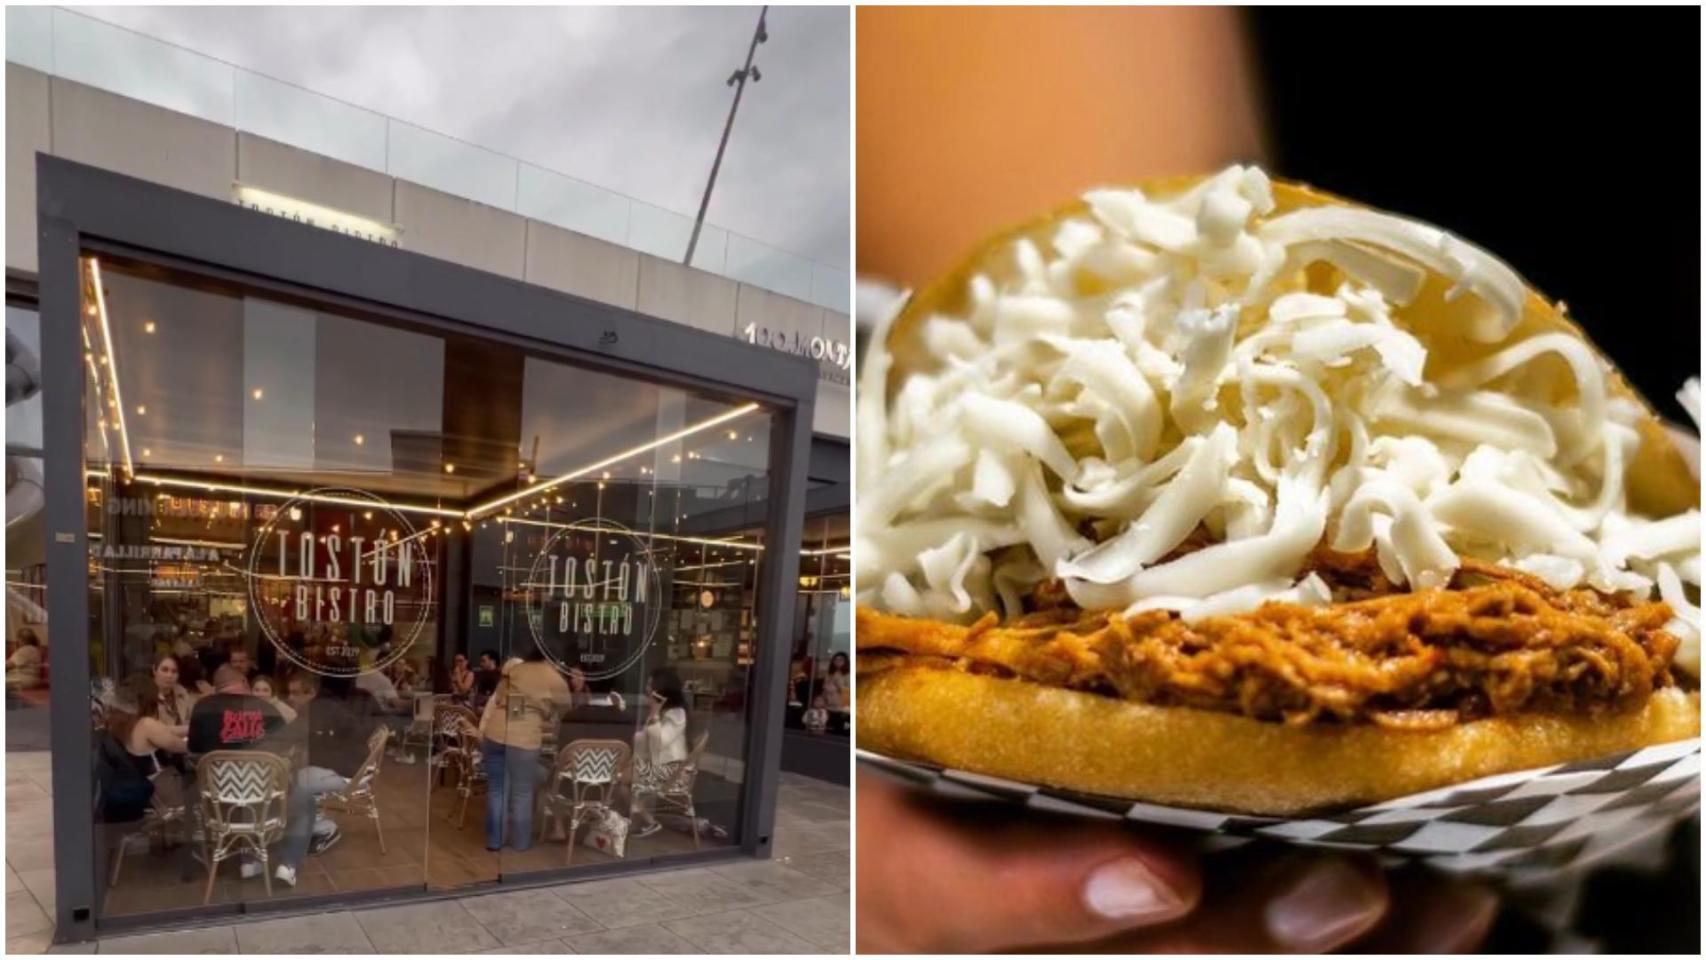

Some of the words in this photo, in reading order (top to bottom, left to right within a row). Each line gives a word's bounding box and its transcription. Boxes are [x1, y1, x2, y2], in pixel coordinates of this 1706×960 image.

[277, 528, 413, 587] TOSTÓN
[548, 553, 647, 603] TOSTÓN
[296, 585, 394, 625] BISTRO
[559, 602, 633, 635] BISTRO
